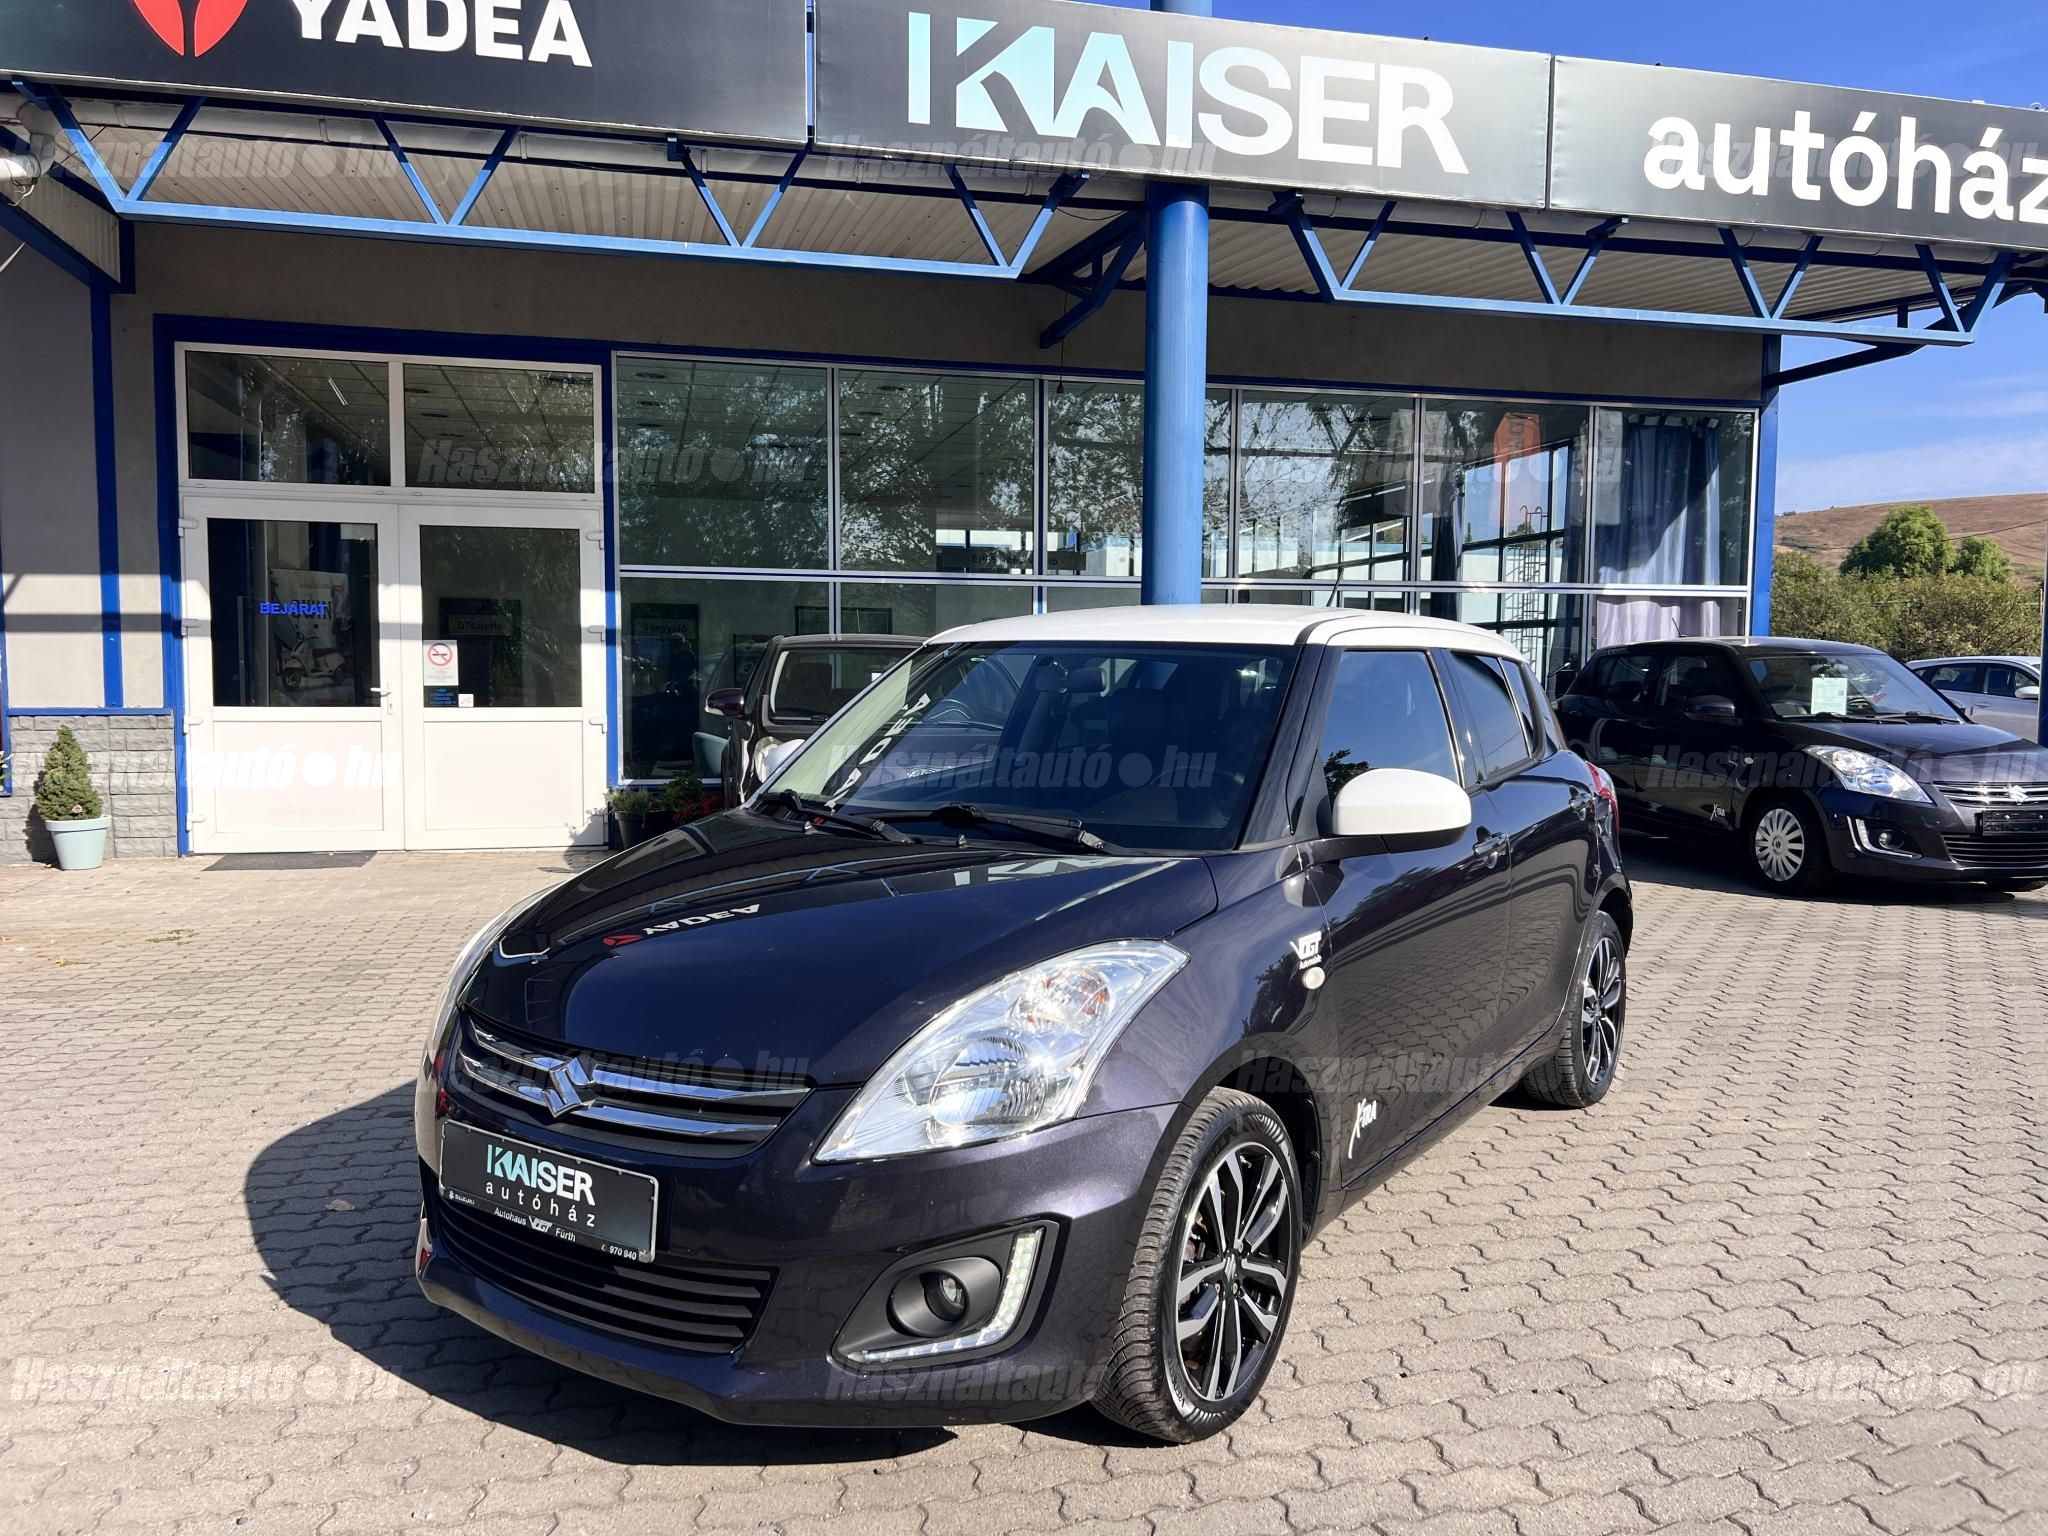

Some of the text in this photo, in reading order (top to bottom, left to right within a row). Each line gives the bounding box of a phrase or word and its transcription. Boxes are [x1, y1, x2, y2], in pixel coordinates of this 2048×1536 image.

[293, 0, 592, 67] YADEA
[908, 12, 1469, 174] KAISER
[260, 601, 328, 615] BEJÁRAT
[486, 1144, 596, 1206] KAISER
[493, 1206, 528, 1226] Autohaus
